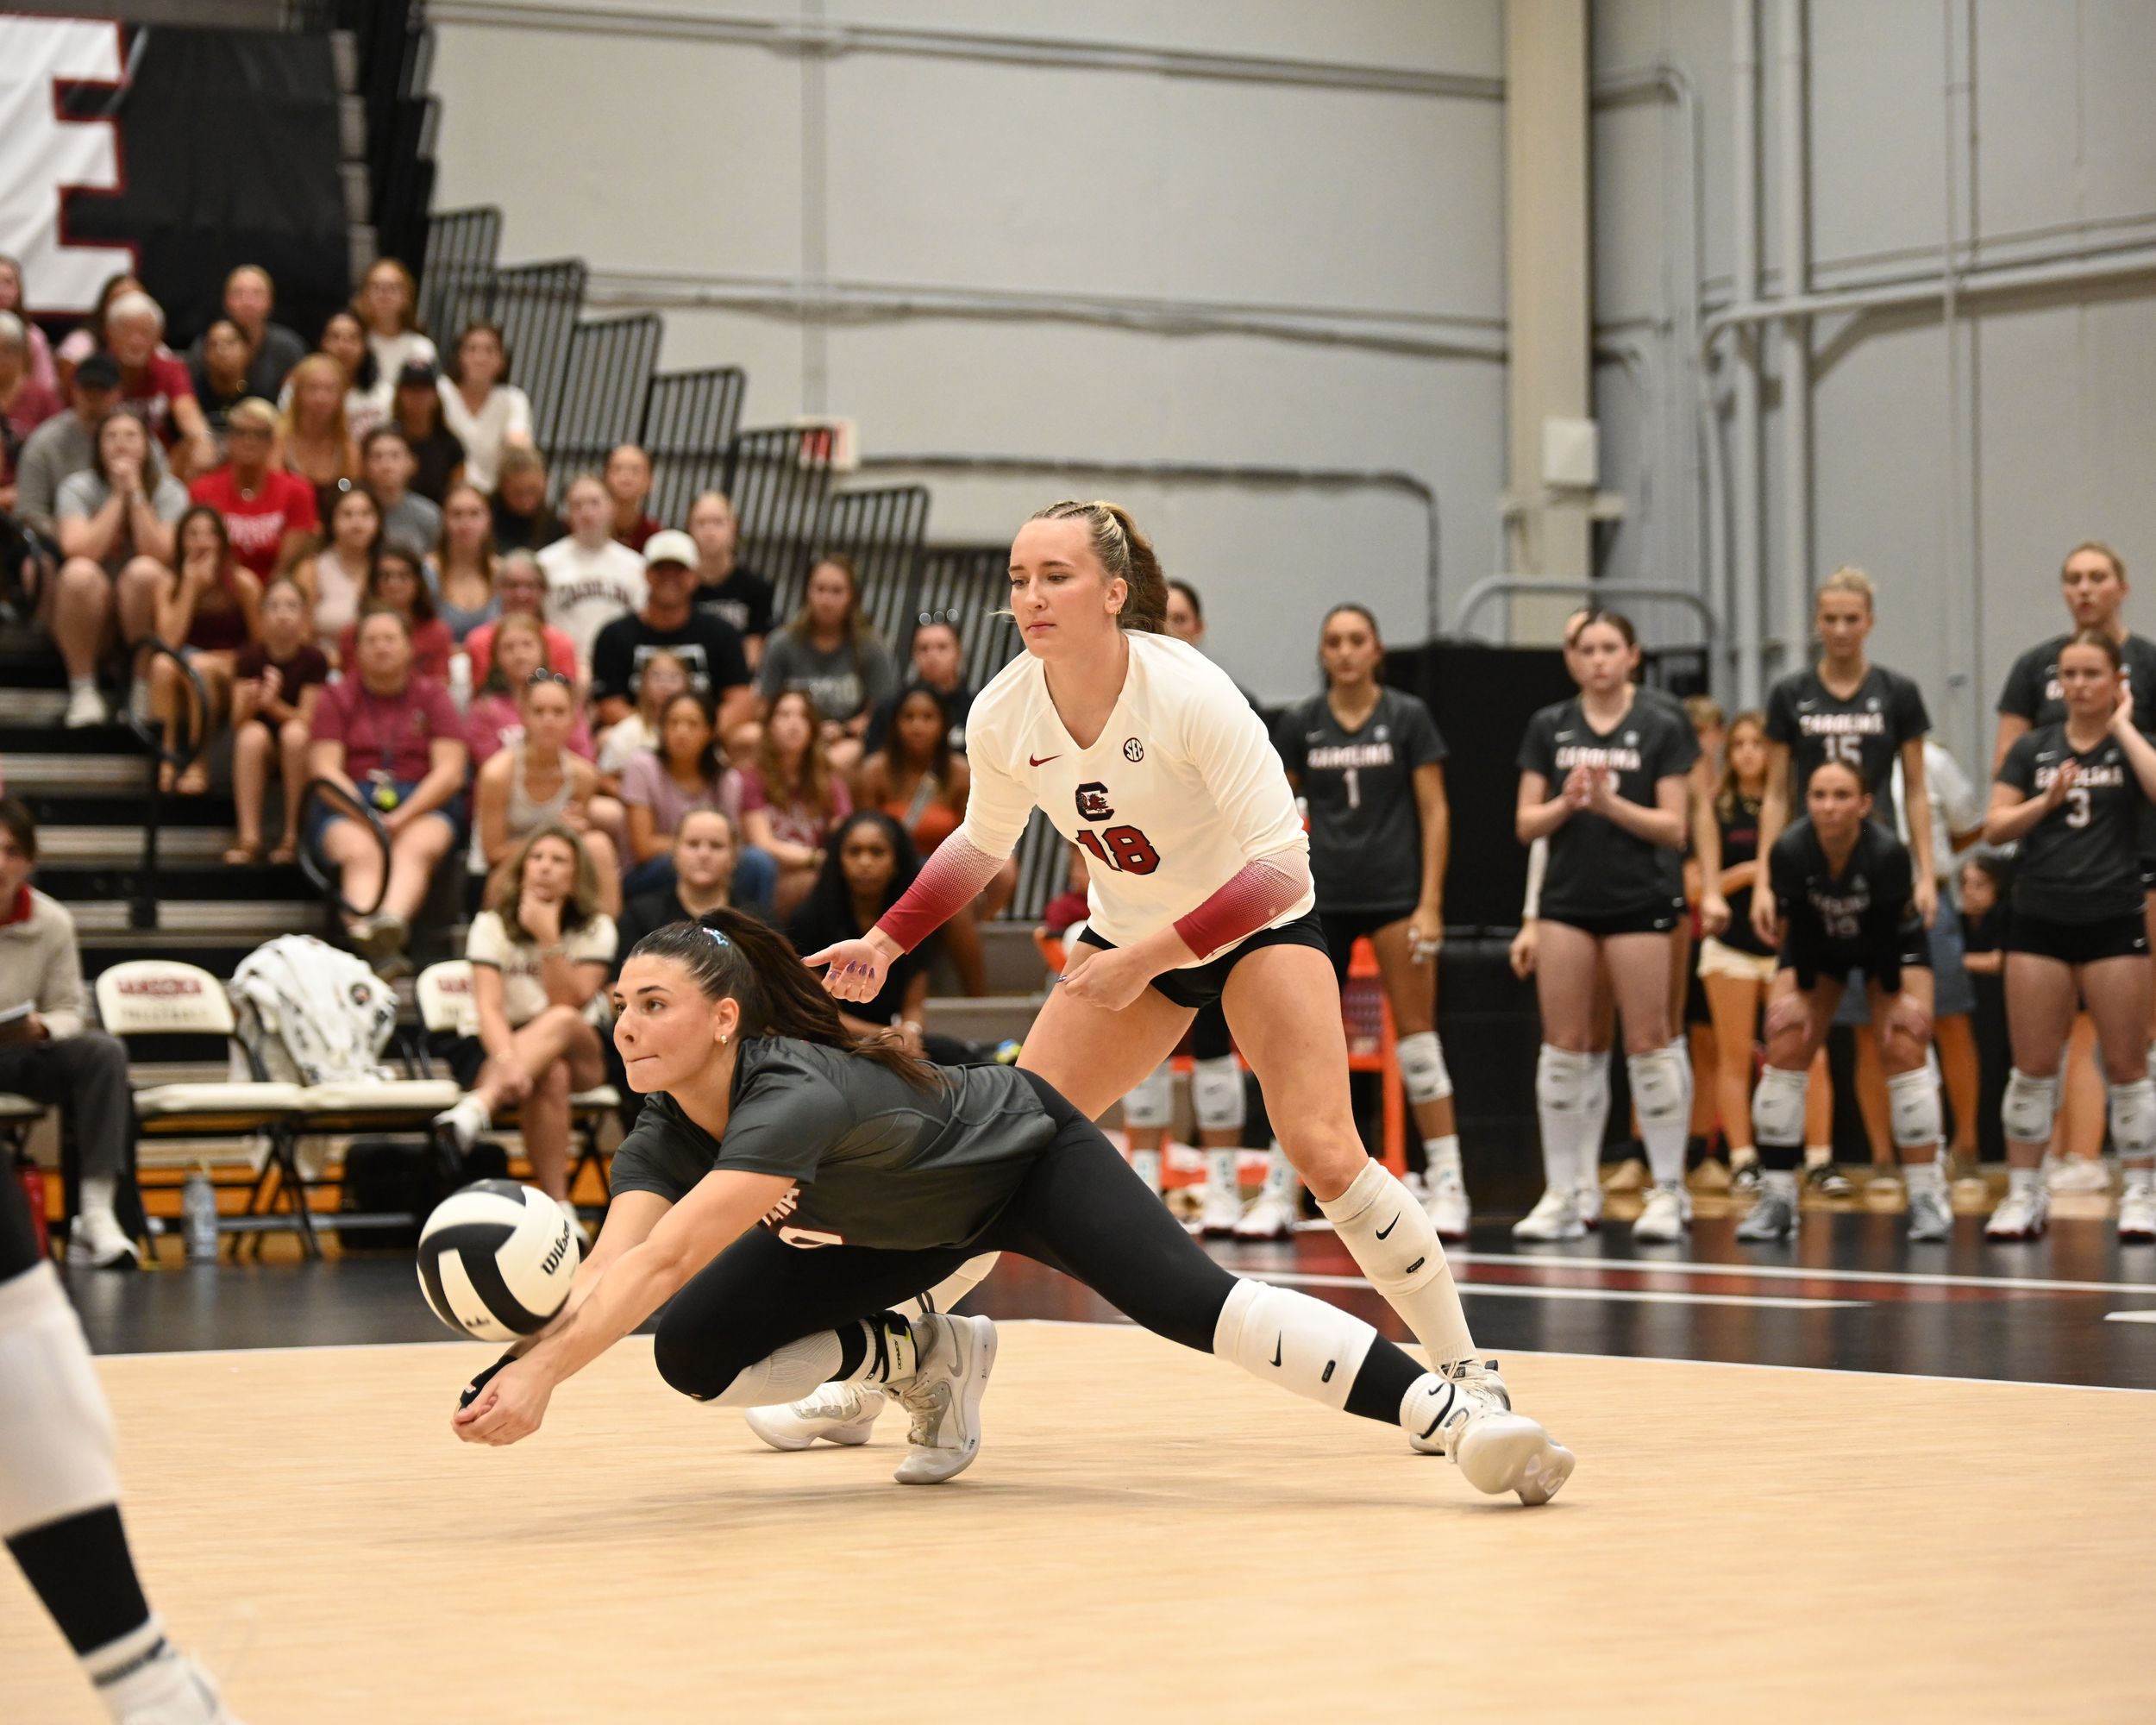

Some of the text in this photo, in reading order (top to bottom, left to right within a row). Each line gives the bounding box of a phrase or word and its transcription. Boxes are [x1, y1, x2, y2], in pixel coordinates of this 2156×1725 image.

[1799, 714, 1884, 737] CAROLINA
[1124, 738, 1144, 762] SEC
[1307, 743, 1393, 768] CAROLINA
[1556, 746, 1641, 771] CAROLINA
[1824, 734, 1863, 767] 15
[1342, 768, 1360, 808] 1
[2066, 788, 2090, 828] 3
[1075, 825, 1161, 875] 18
[541, 1219, 570, 1276] Wilson
